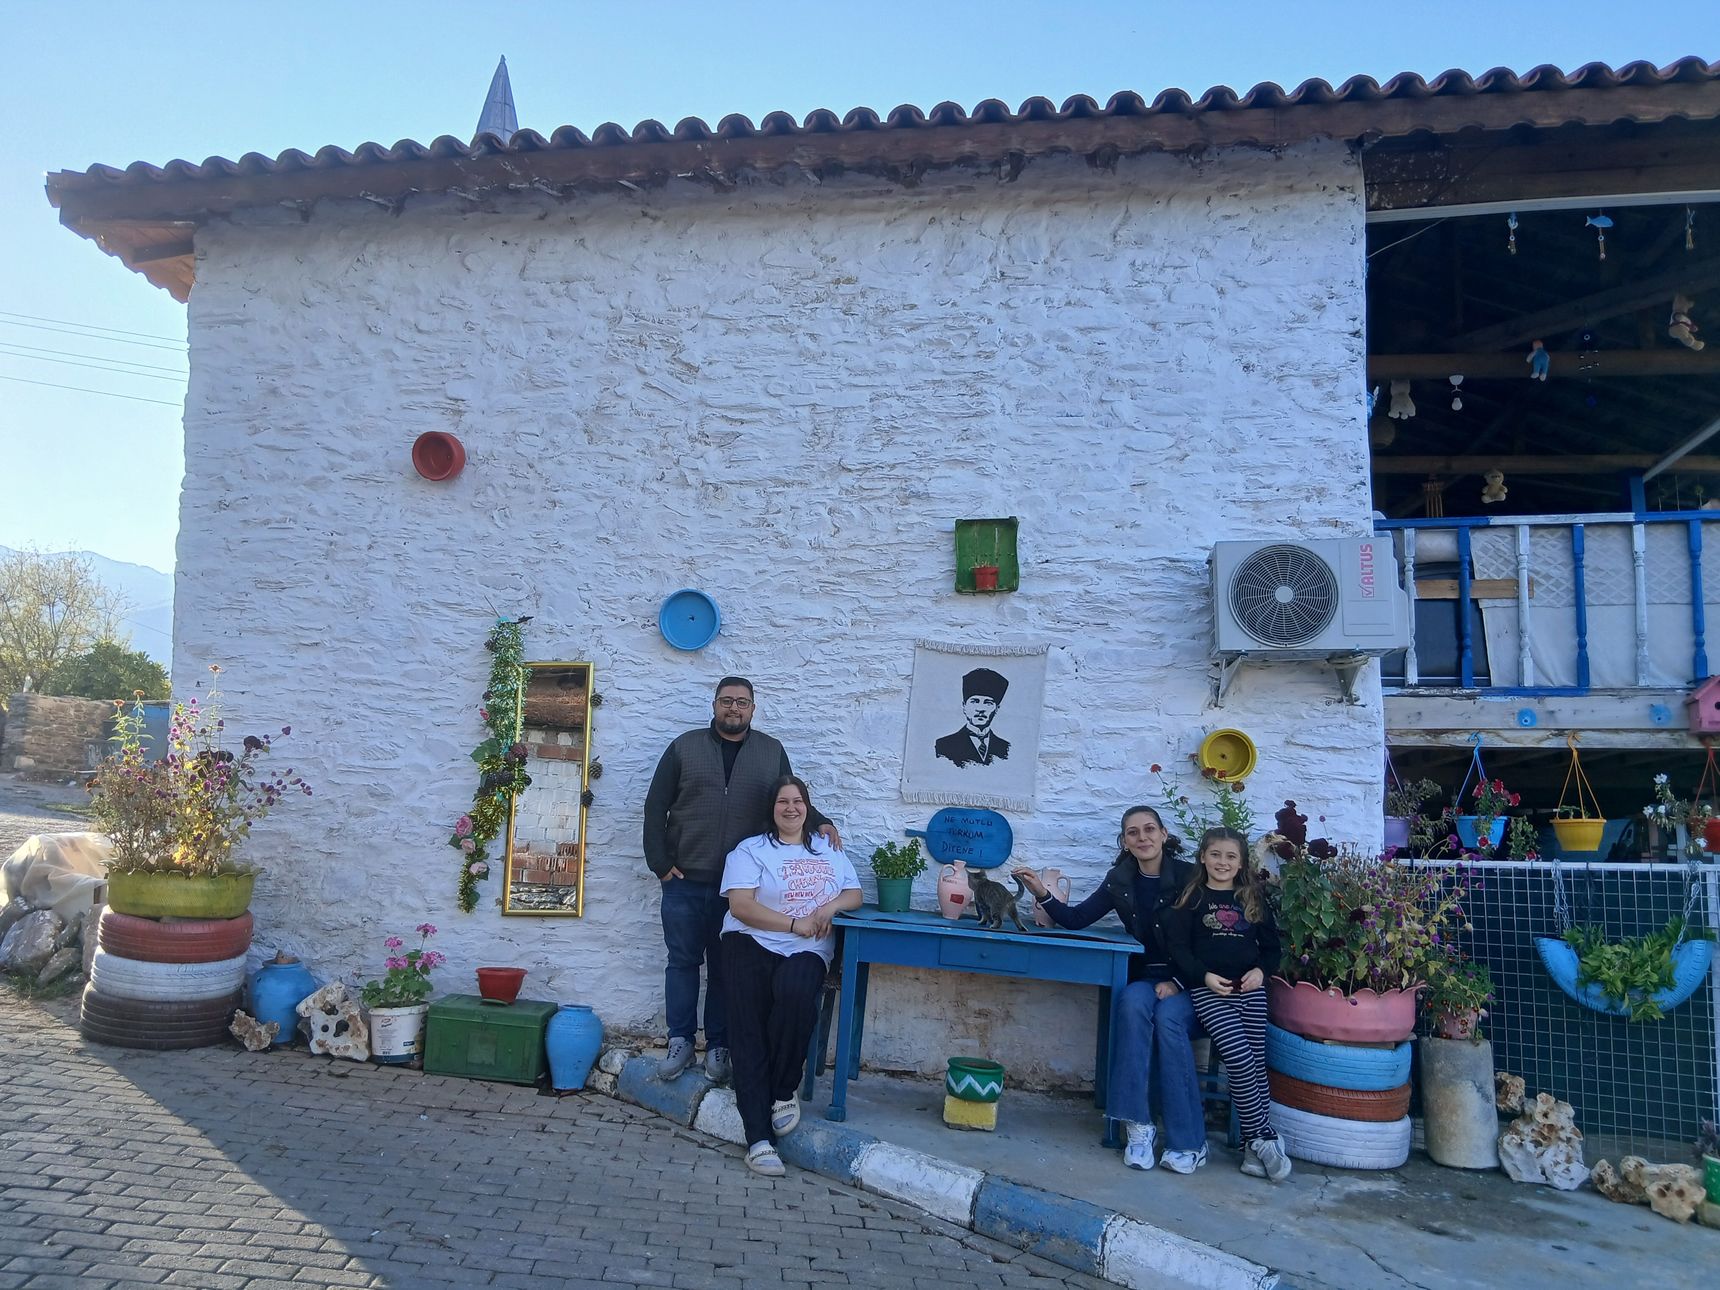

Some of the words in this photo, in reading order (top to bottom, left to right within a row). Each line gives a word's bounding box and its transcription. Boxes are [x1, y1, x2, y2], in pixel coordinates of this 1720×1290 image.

[1360, 544, 1374, 586] ALTUS
[944, 815, 956, 824] NE
[960, 817, 993, 827] MUTLU
